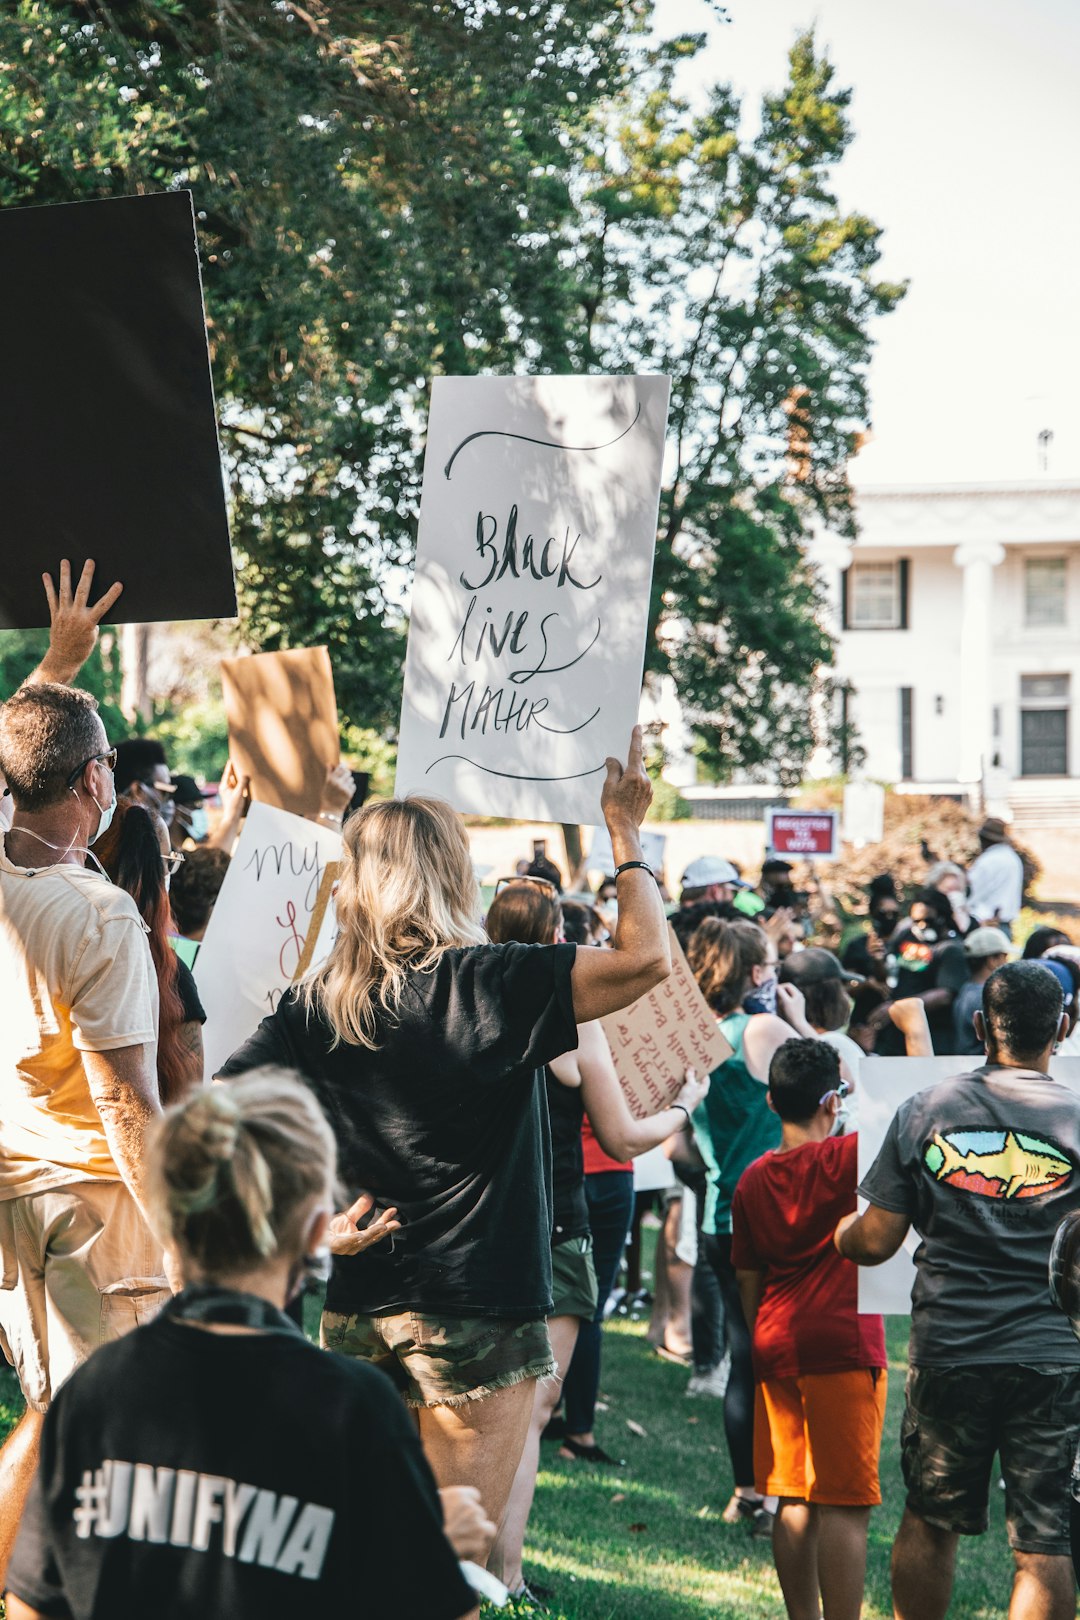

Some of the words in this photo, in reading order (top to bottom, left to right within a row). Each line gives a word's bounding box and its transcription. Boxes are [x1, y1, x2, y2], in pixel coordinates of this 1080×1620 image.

[648, 993, 667, 1029] Beca
[673, 1000, 686, 1022] too
[639, 1033, 682, 1095] JUSTICE
[667, 1030, 696, 1073] sually
[631, 1047, 667, 1110] Hungry
[73, 1459, 335, 1580] #UNIFYNA
